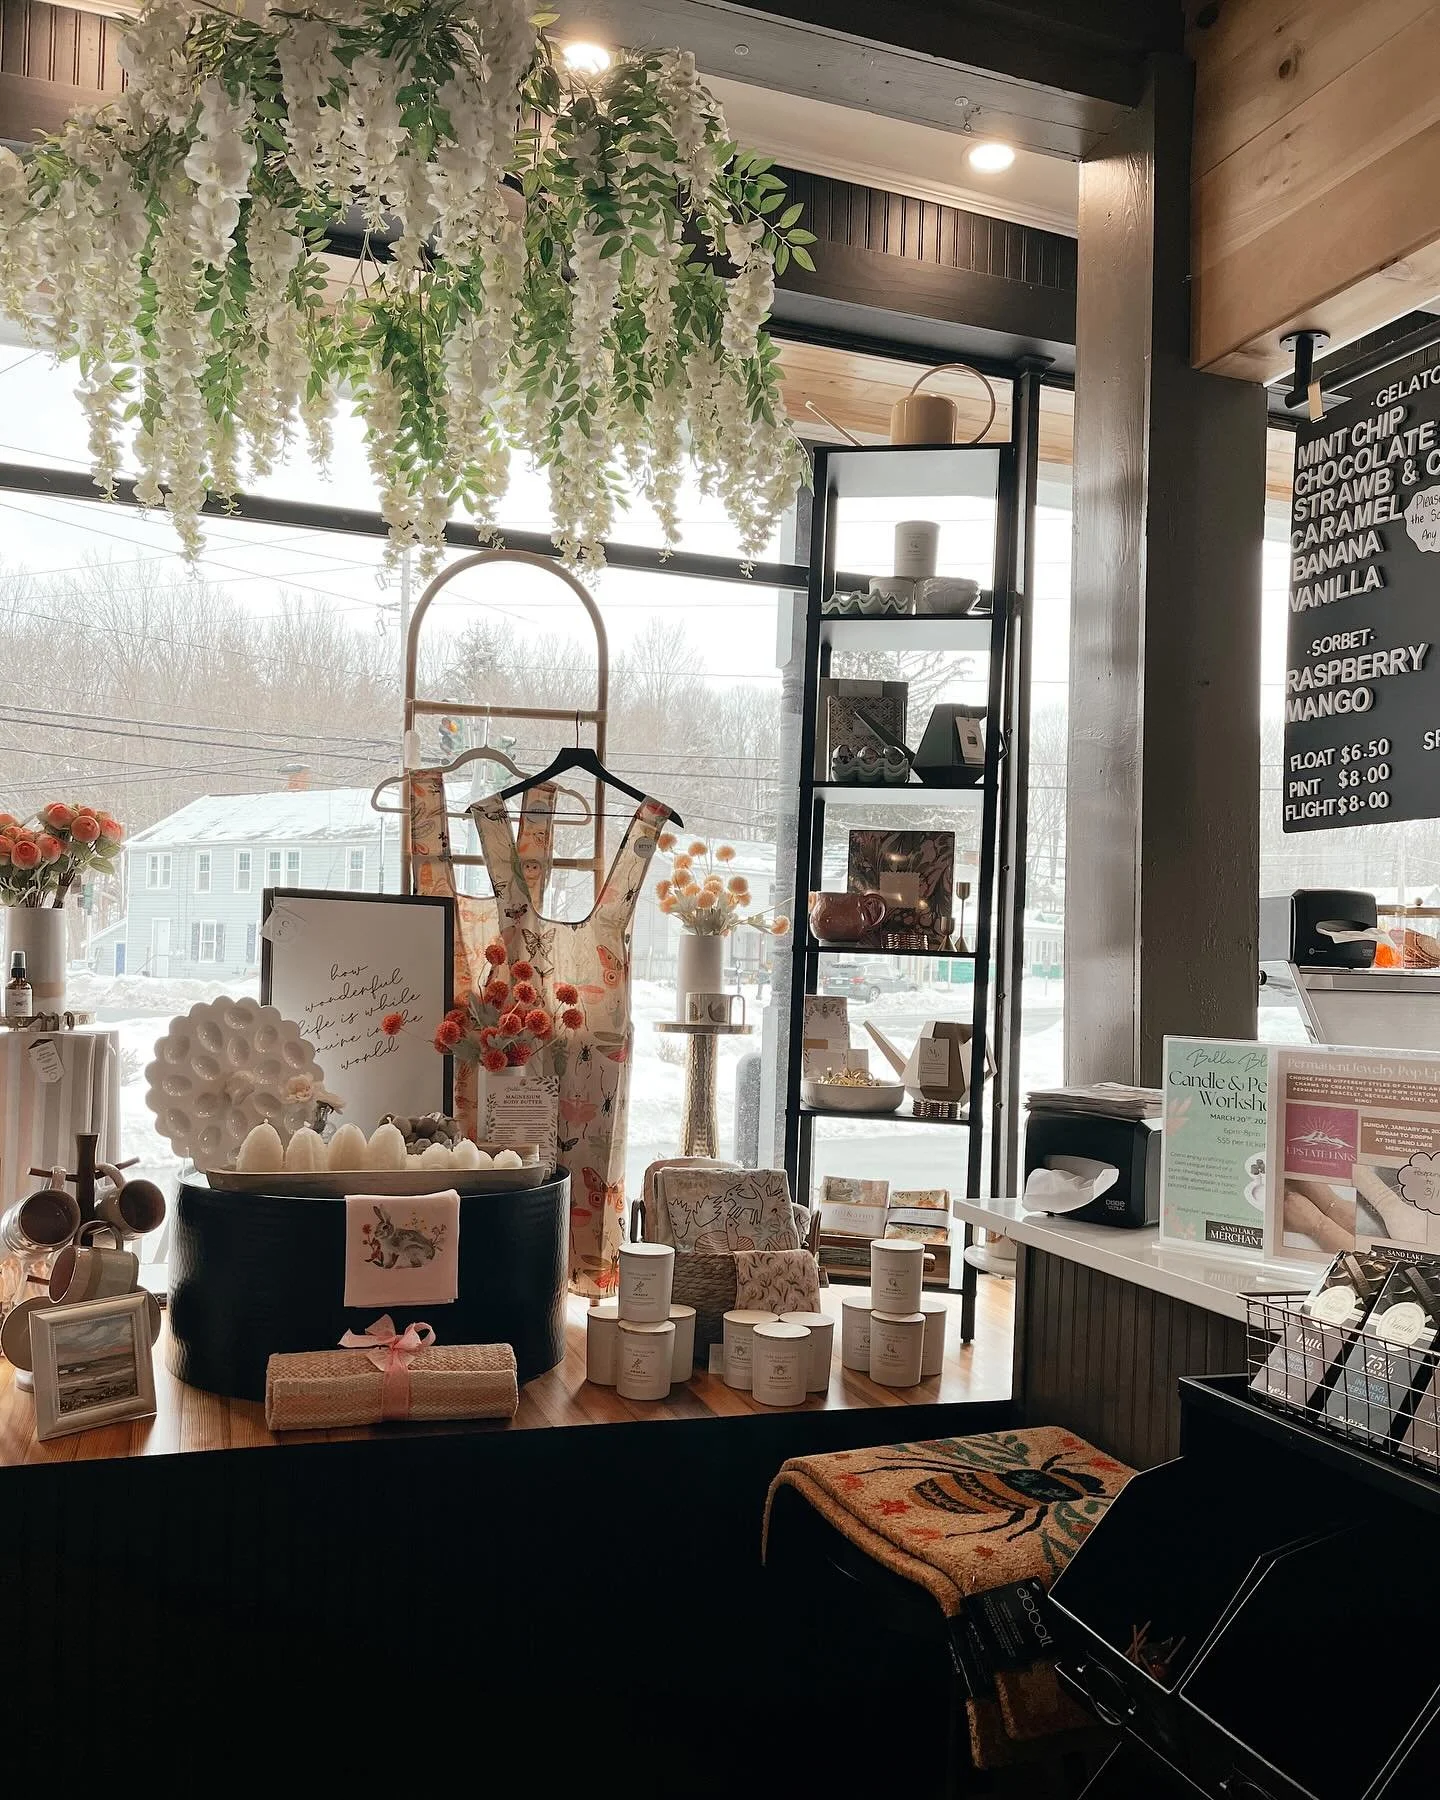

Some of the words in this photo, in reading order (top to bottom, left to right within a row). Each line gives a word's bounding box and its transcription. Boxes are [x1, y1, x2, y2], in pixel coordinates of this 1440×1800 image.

[1298, 427, 1350, 470] MINT
[1352, 405, 1407, 447] CHIP
[1295, 420, 1436, 495] CHOCOLATE
[1294, 467, 1393, 522] STRAWB
[1402, 459, 1419, 485] &
[1291, 495, 1404, 552] CARAMEL
[1422, 529, 1436, 546] Any
[1293, 530, 1383, 582] BANANA
[1289, 565, 1384, 612] VANILLA
[1287, 642, 1429, 694] RASPBERRY
[1285, 686, 1373, 723] MANGO
[1290, 748, 1336, 772] FLOAT
[1340, 738, 1390, 765] $6.50
[1289, 778, 1322, 798] PINT
[1338, 763, 1390, 789] $8.00
[1285, 799, 1337, 821] FLIGHT
[330, 963, 368, 981] how
[305, 968, 403, 1013] wonderful
[299, 1014, 335, 1037] life
[340, 1012, 358, 1025] is
[365, 987, 421, 1017] while
[340, 1038, 399, 1070] world
[1287, 1058, 1350, 1073] Permanent
[1352, 1062, 1394, 1079] Jewelry
[1169, 1070, 1225, 1090] Candle
[1228, 1075, 1244, 1091] &
[1210, 1113, 1235, 1121] MARCH
[1220, 1225, 1237, 1234] SAND
[1238, 1227, 1255, 1236] LAKE
[1387, 1250, 1406, 1258] SAND
[1406, 1252, 1424, 1261] LAKE
